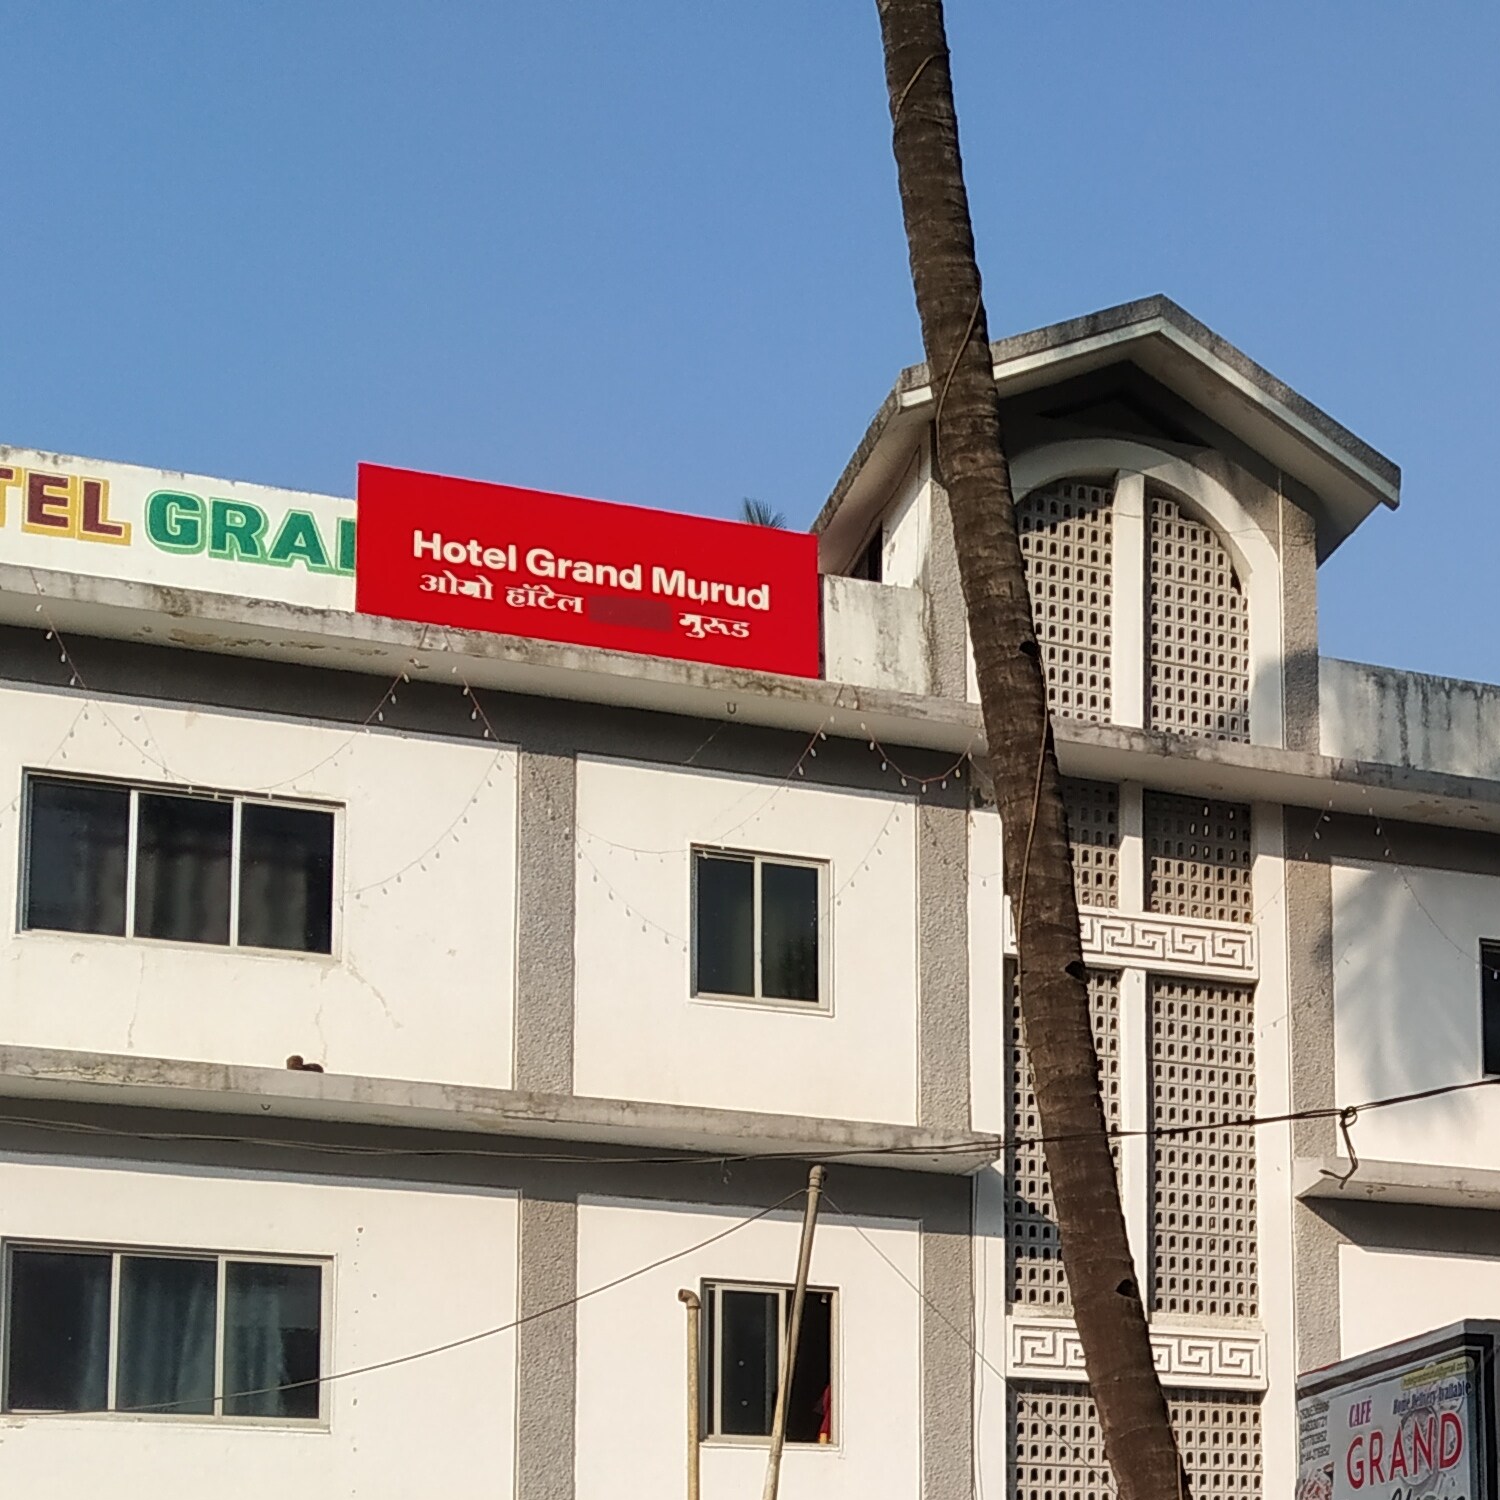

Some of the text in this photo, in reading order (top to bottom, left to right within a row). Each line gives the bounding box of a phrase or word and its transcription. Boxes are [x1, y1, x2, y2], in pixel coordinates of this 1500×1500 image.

[412, 529, 771, 612] Hotel Grand Murud
[504, 582, 584, 614] हॉटेल
[1348, 1396, 1373, 1428] CAFÉ
[1345, 1412, 1465, 1490] GRAND
